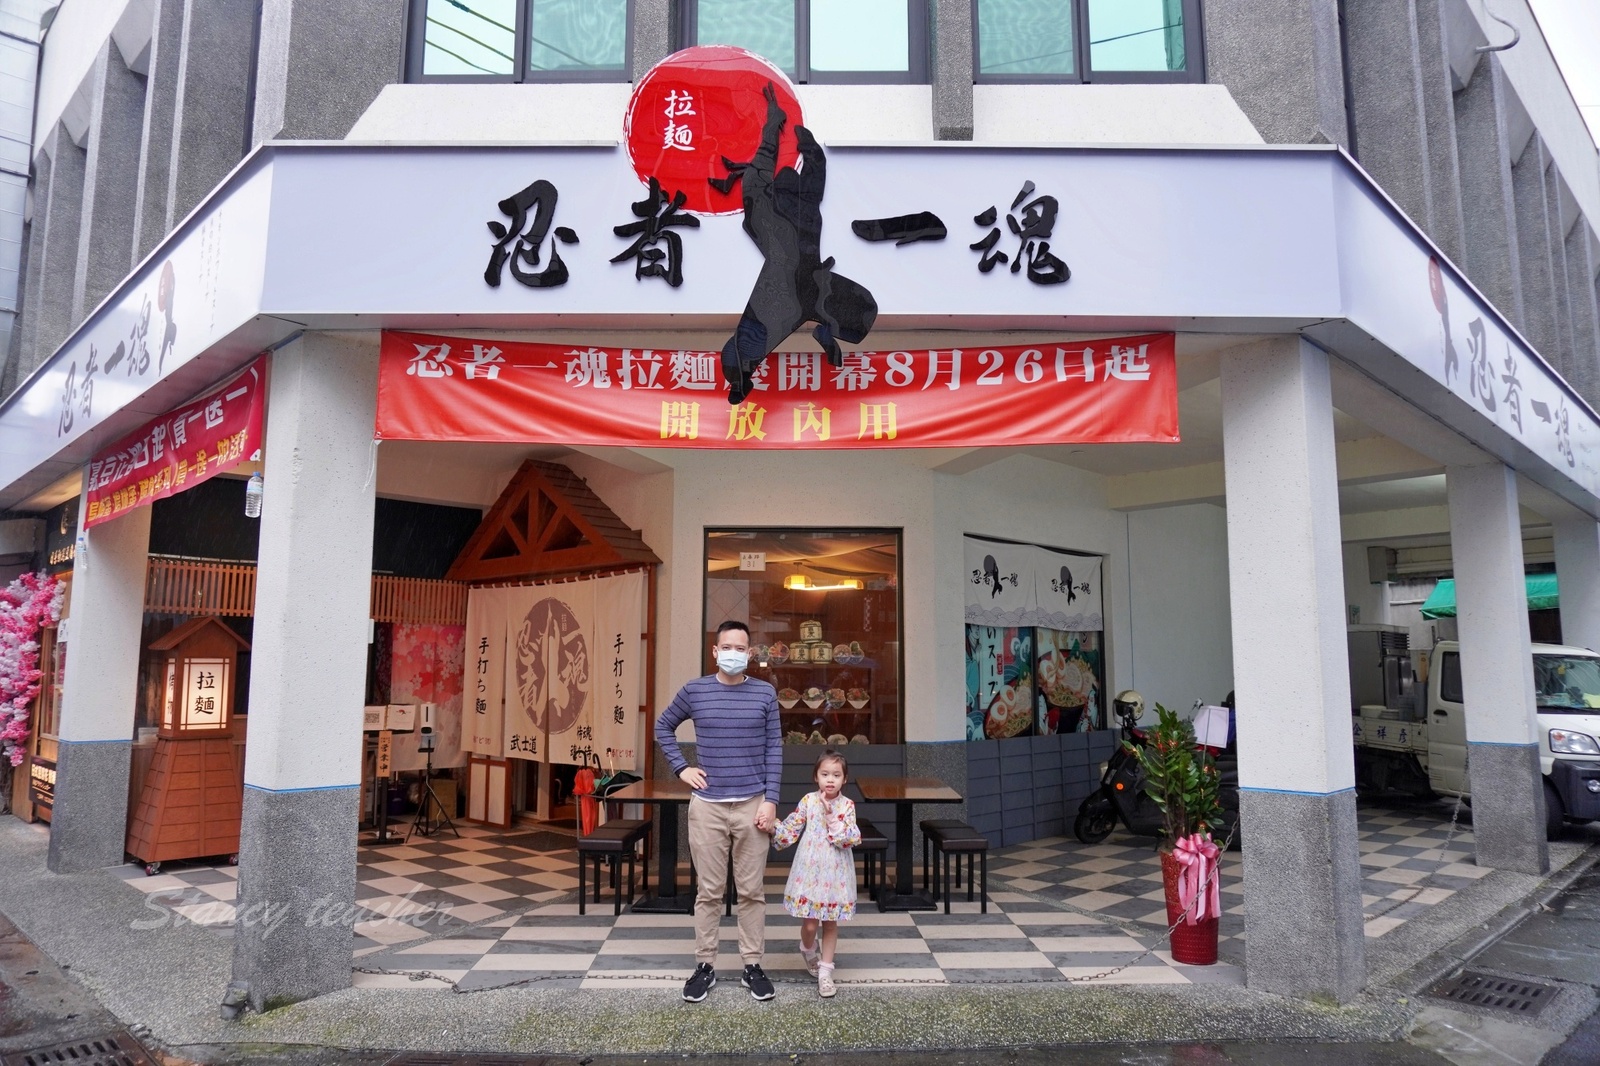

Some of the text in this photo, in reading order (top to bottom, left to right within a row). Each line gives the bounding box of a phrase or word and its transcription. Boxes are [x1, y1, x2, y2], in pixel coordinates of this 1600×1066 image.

[663, 89, 696, 151] 拉麵
[484, 177, 1071, 288] 忍者一魂
[1466, 315, 1576, 468] 忍者一魂
[970, 569, 1019, 588] 忍者一魂
[194, 671, 216, 715] 拉麵
[510, 734, 538, 755] 武士道
